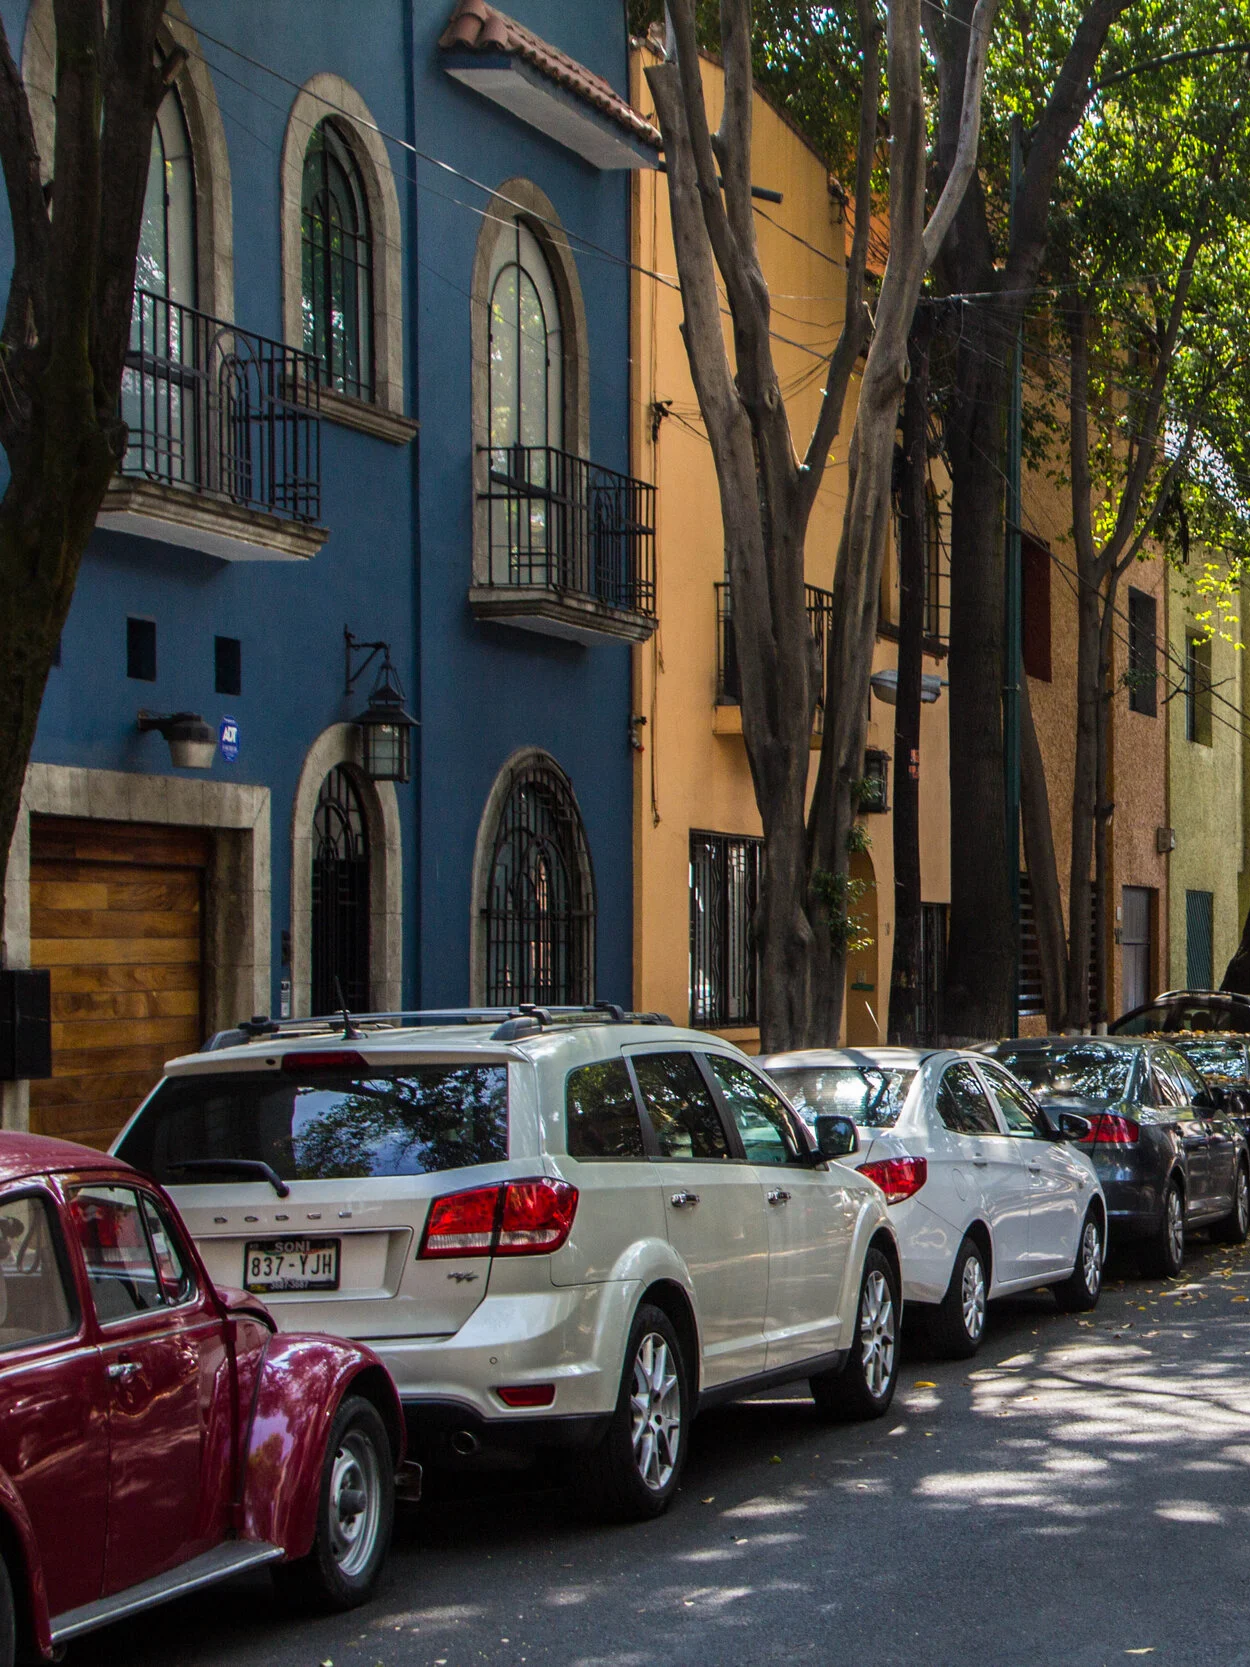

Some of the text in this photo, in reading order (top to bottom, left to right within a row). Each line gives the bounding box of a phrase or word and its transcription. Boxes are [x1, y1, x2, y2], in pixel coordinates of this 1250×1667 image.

[222, 725, 237, 743] ADT
[213, 1211, 352, 1224] DODGE
[275, 1241, 311, 1253] SONI
[251, 1254, 332, 1277] 837-YJH
